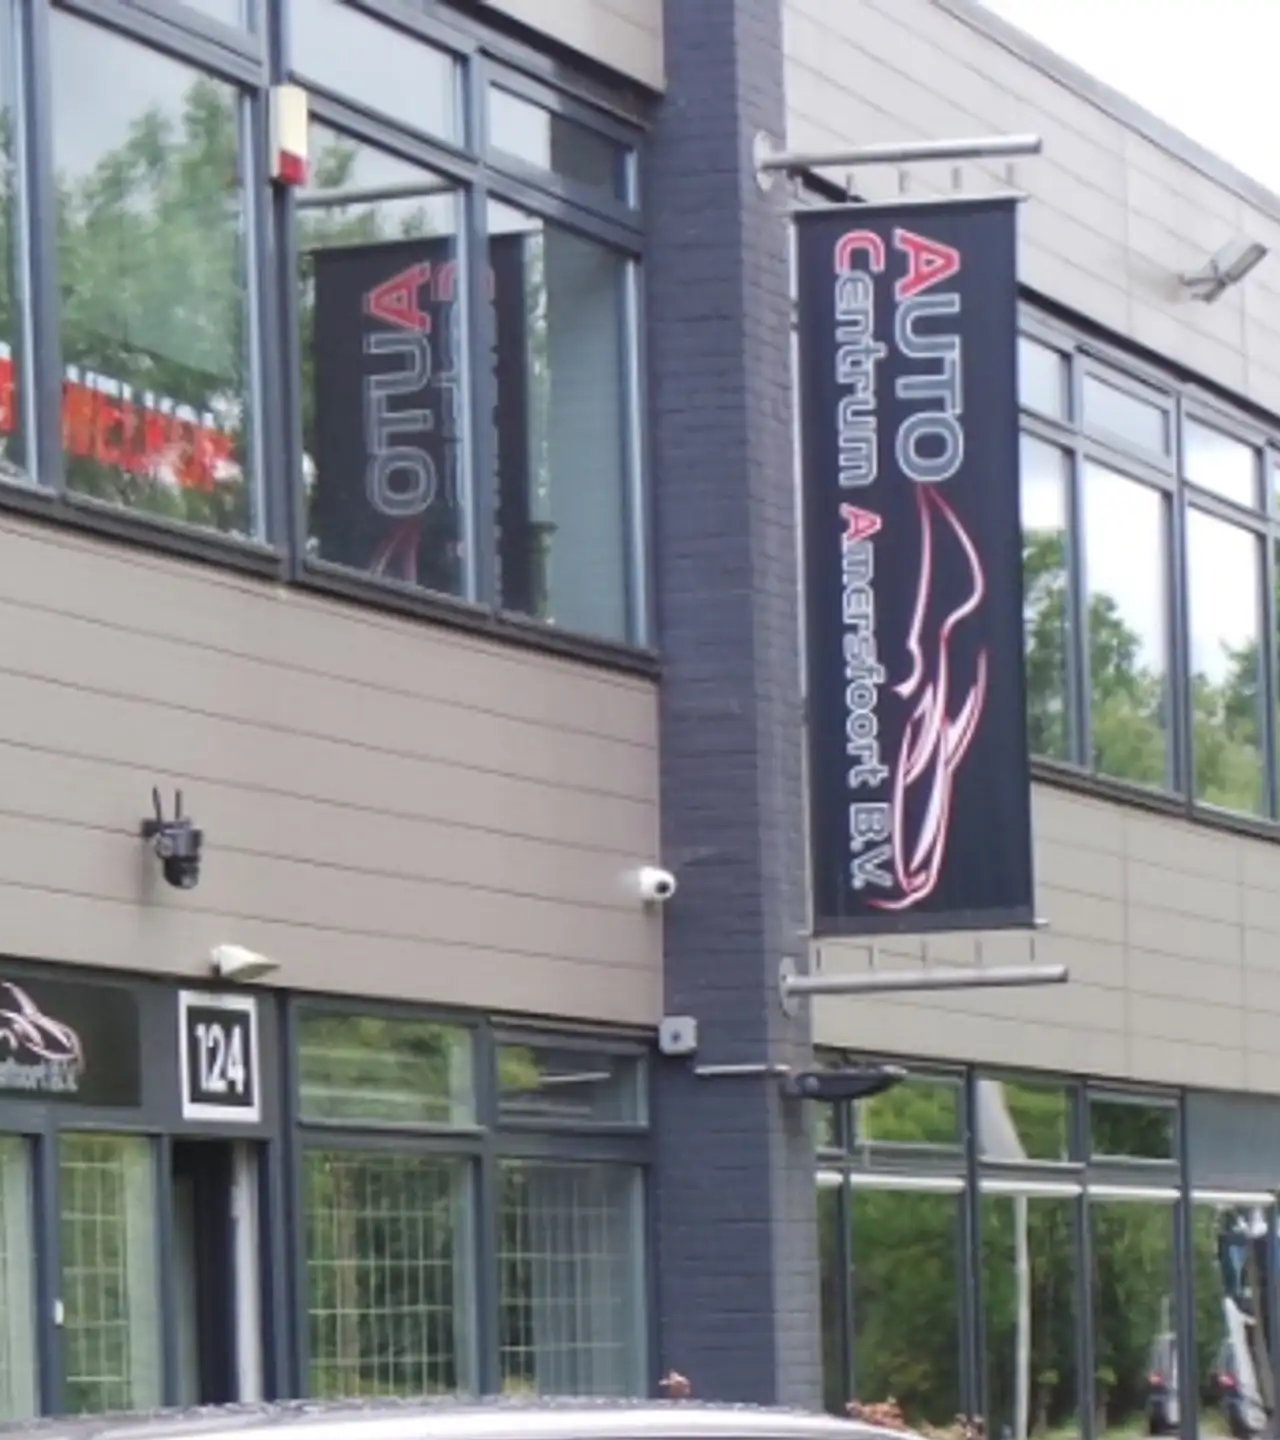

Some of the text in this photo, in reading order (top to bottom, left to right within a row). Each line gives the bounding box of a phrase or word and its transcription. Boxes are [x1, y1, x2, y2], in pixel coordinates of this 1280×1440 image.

[893, 226, 964, 482] AUTO
[834, 229, 894, 889] Centrum Amersfoort B.V.
[194, 1022, 245, 1096] 124
